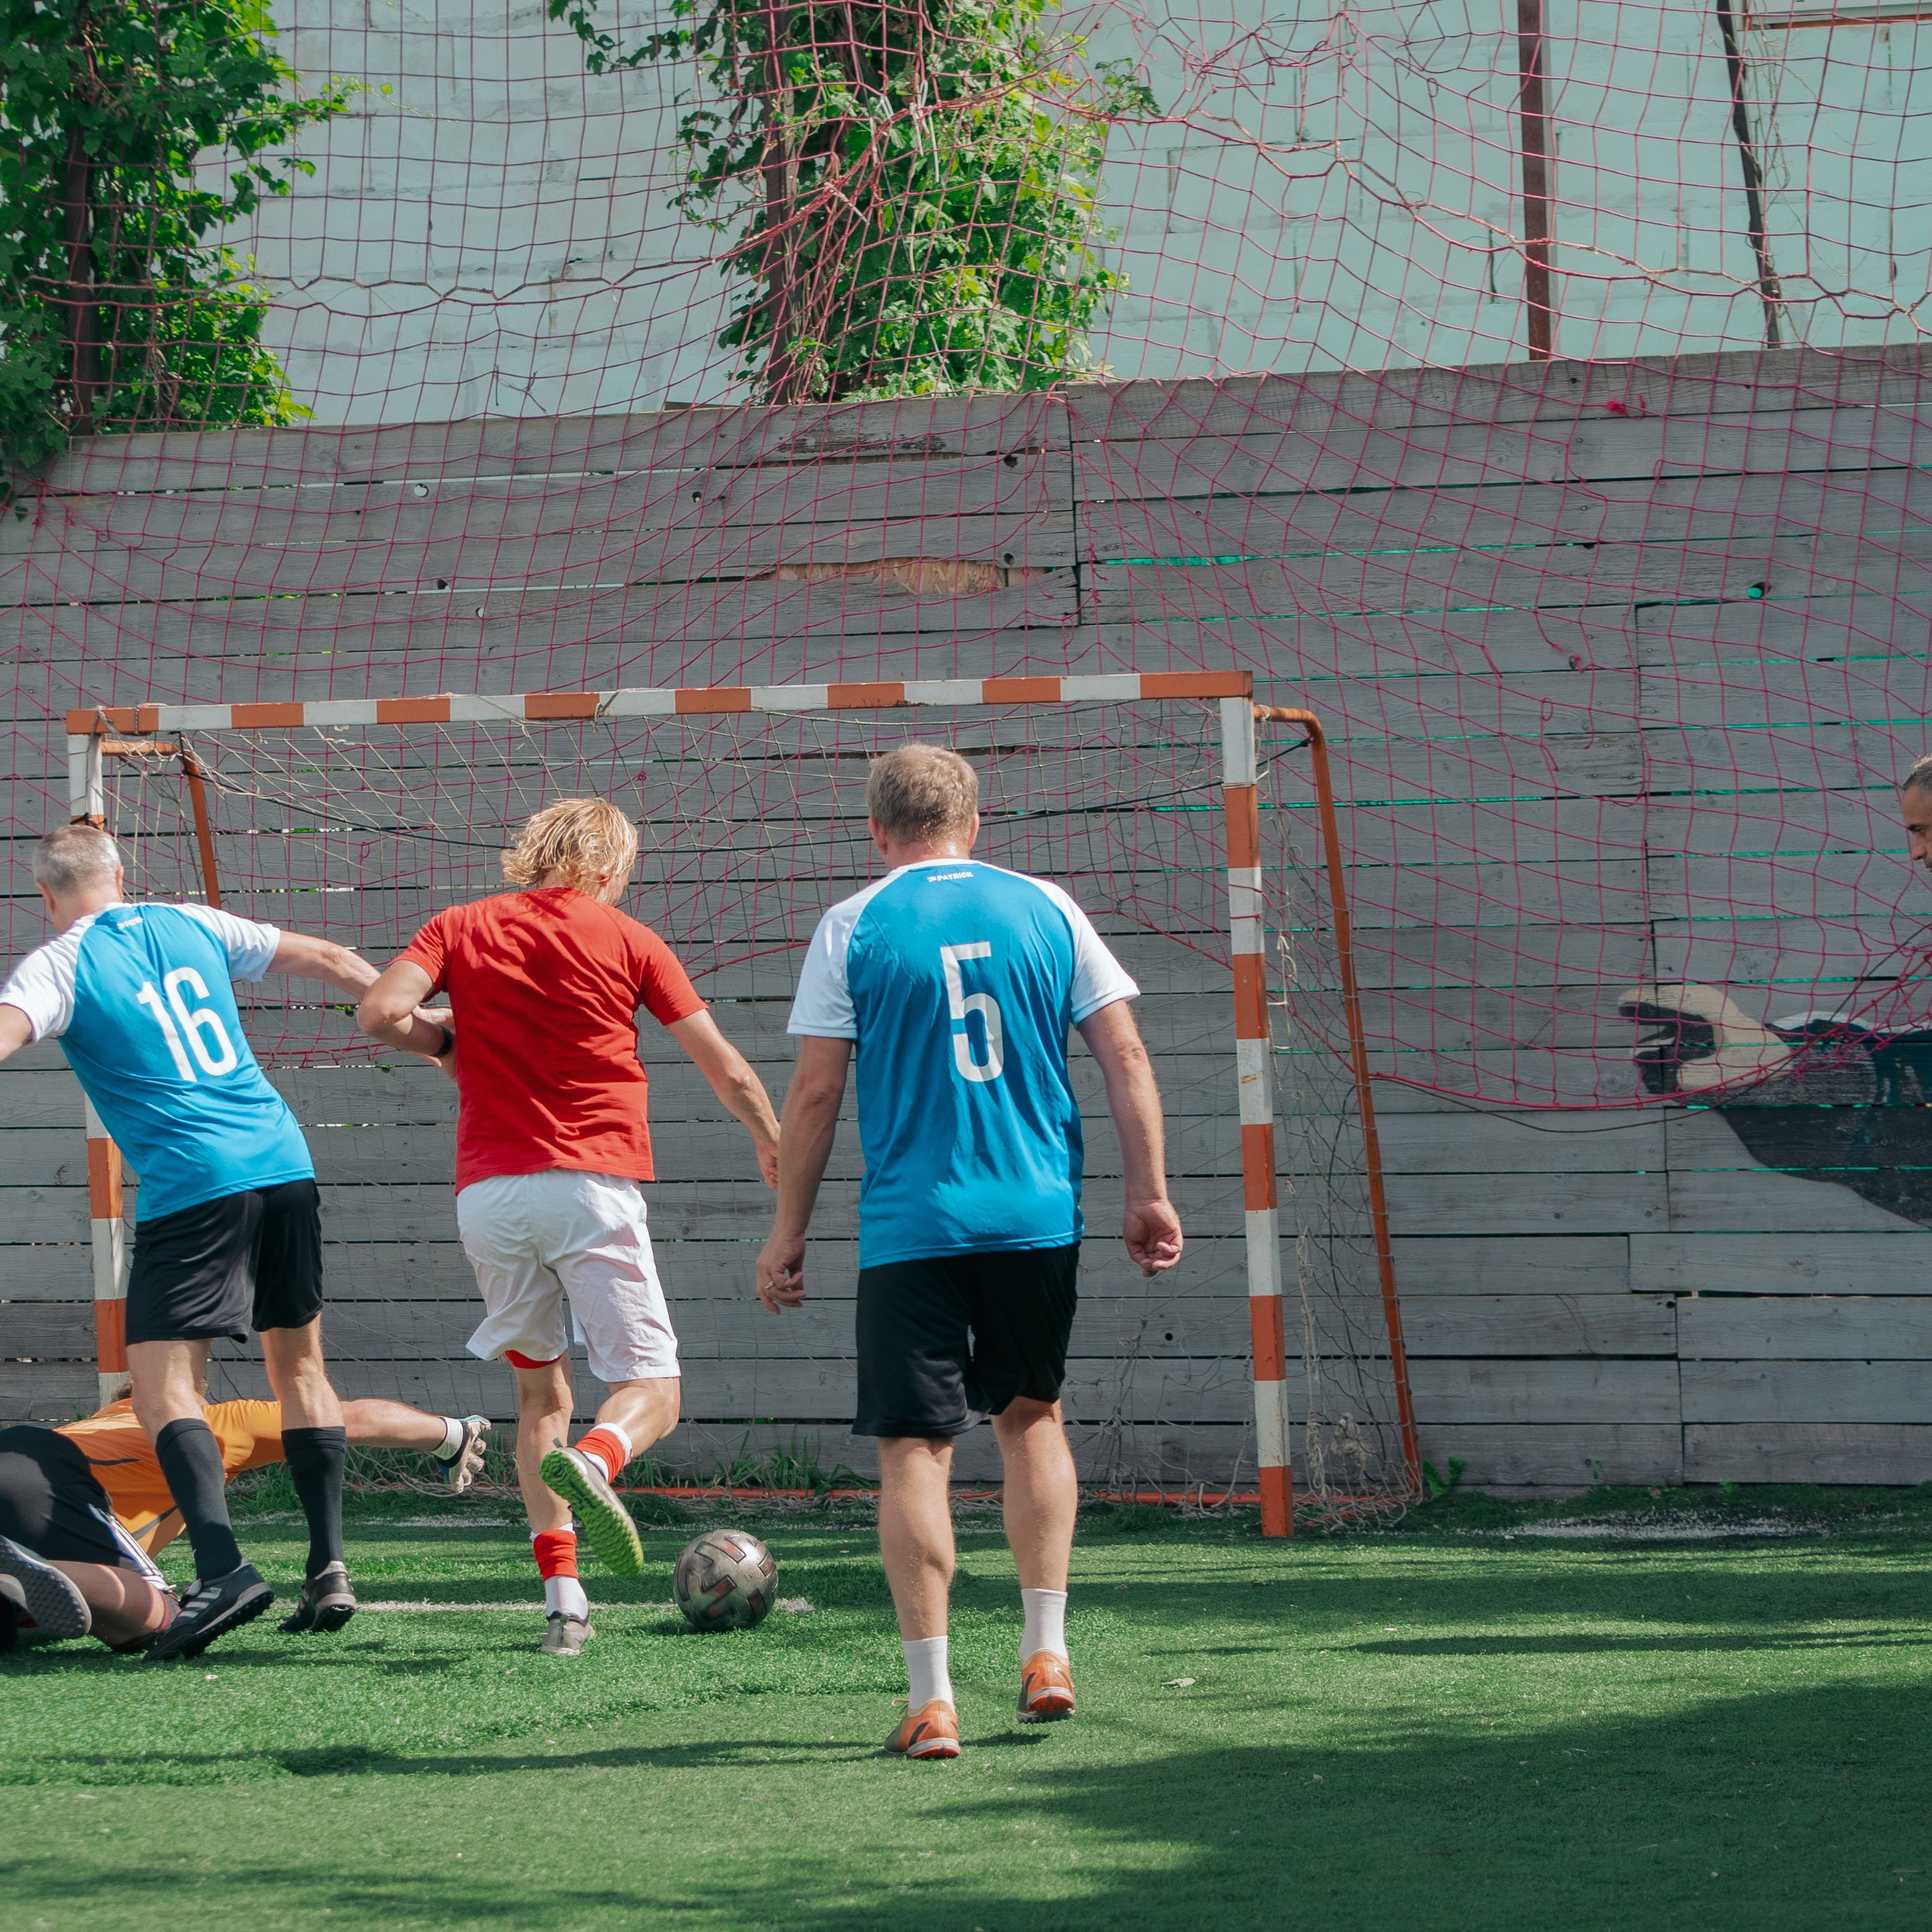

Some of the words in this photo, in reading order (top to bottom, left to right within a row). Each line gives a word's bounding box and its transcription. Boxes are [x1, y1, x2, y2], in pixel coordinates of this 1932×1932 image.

[937, 871, 974, 881] PATRICK
[136, 967, 238, 1082] 16
[940, 941, 1004, 1082] 5
